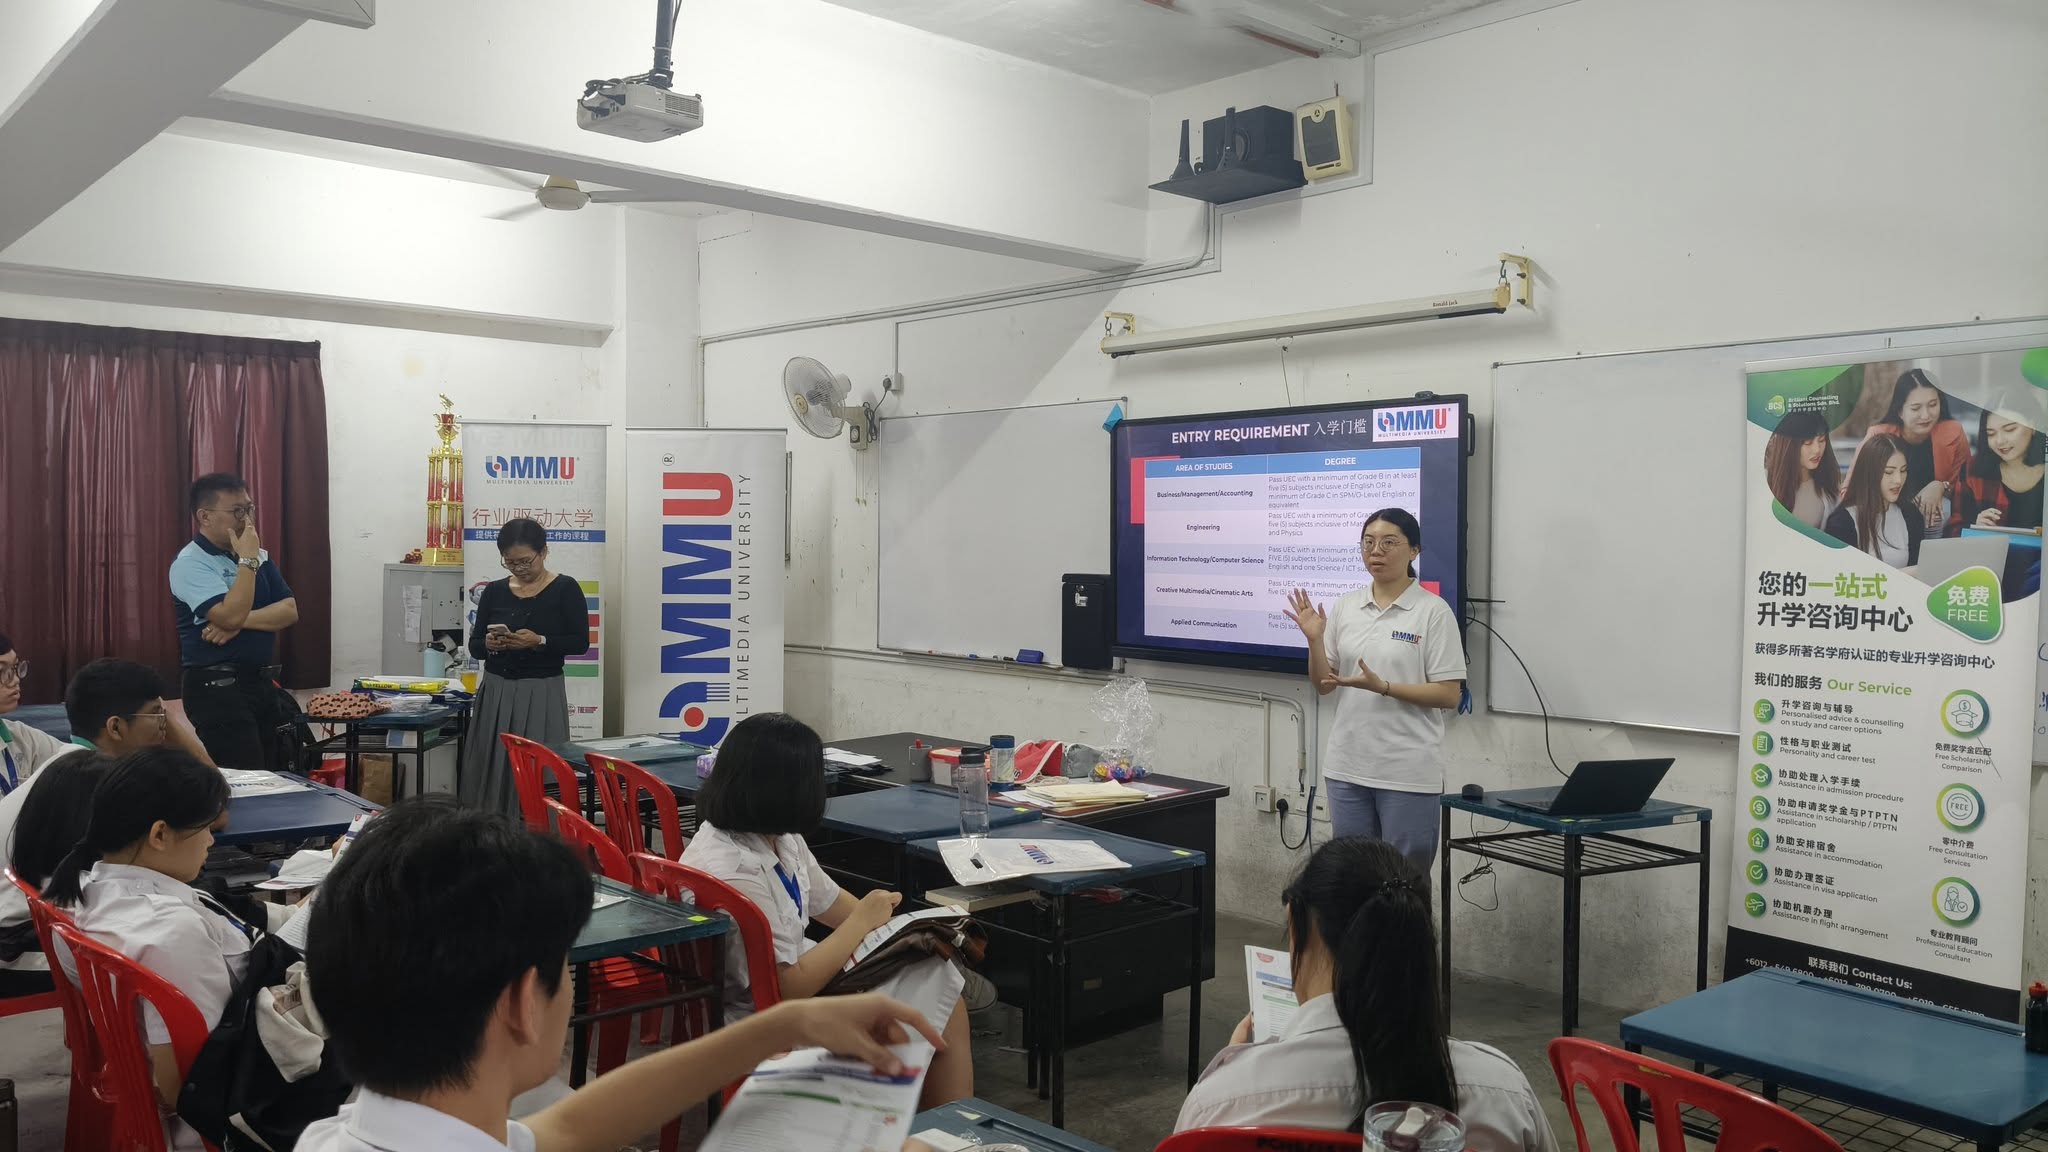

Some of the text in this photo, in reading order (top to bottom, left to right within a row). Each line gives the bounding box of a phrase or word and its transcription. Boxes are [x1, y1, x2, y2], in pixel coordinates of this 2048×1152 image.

[1396, 408, 1447, 432] MMU
[1172, 418, 1367, 444] ENTRY REQUIREMENT 入学门槛
[510, 456, 575, 479] MMU
[1175, 464, 1193, 472] AREA
[1204, 463, 1233, 471] STUDIES
[1324, 457, 1357, 466] DEGREE
[1156, 490, 1253, 499] Business/Management/Accounting
[1288, 484, 1314, 492] subjects
[1350, 483, 1375, 491] English
[1382, 491, 1407, 499] English
[1178, 556, 1241, 564] Technology/Computer
[1268, 564, 1290, 572] English
[1290, 555, 1316, 563] subjects
[660, 472, 734, 673] MMU
[1179, 588, 1240, 597] Multimedia/Cinematic
[1758, 571, 1888, 600] 您的一站式
[736, 474, 751, 725] LTIMEDIA UNIVERSITY
[1946, 585, 1990, 607] 免费
[1170, 619, 1238, 629] Applied Communication
[1758, 602, 1913, 633] 升学咨询中心
[1947, 609, 1989, 622] FREE
[1754, 642, 1995, 669] 获得多所著名学府认证的专业升学咨询中心
[1754, 672, 1912, 696] 我们的服务 Our Service
[1781, 699, 1854, 714] 升学咨询与辅导
[1781, 709, 1827, 720] Personalised
[1828, 714, 1853, 722] advice
[1861, 717, 1904, 729] counselling
[1791, 719, 1812, 729] study
[1813, 721, 1828, 729] and
[1829, 724, 1852, 732] career
[1854, 725, 1882, 736] options
[1779, 736, 1852, 753] 性格与职业测试
[1935, 742, 1992, 756] 免费奖学金匹配
[1779, 746, 1876, 764] Personality and career test
[1951, 755, 1991, 765] Scholarship
[1941, 763, 1982, 774] Comparison
[1778, 768, 1861, 788] 协助处理入学手续
[1778, 779, 1904, 804] Assistance in admission procedure
[1777, 797, 1898, 822] 协助申请奖学金与PTPTN
[1950, 802, 1969, 812] FREE
[1776, 816, 1817, 830] application
[1777, 808, 1815, 819] Assistance
[1816, 813, 1824, 821] in
[1824, 814, 1867, 829] scholarship
[1872, 822, 1898, 832] PTPTN
[1775, 834, 1836, 853] 协助安排宿舍
[1942, 837, 1975, 849] 零中介费
[1775, 845, 1883, 870] Assistance in accommodation
[1928, 845, 1988, 861] Free Consultation
[1943, 857, 1971, 868] Services
[1774, 866, 1835, 886] 协助办理签证
[1774, 877, 1878, 904] Assistance in visa application
[1773, 898, 1833, 920] 协助机票办理
[1772, 909, 1889, 941] Assistance in flight arrangement
[1915, 936, 1993, 958] Professional Education
[1934, 949, 1971, 963] Consultant
[1808, 956, 1849, 976] 联系我们
[1852, 968, 1893, 985] Contact
[1896, 978, 1913, 990] Us:
